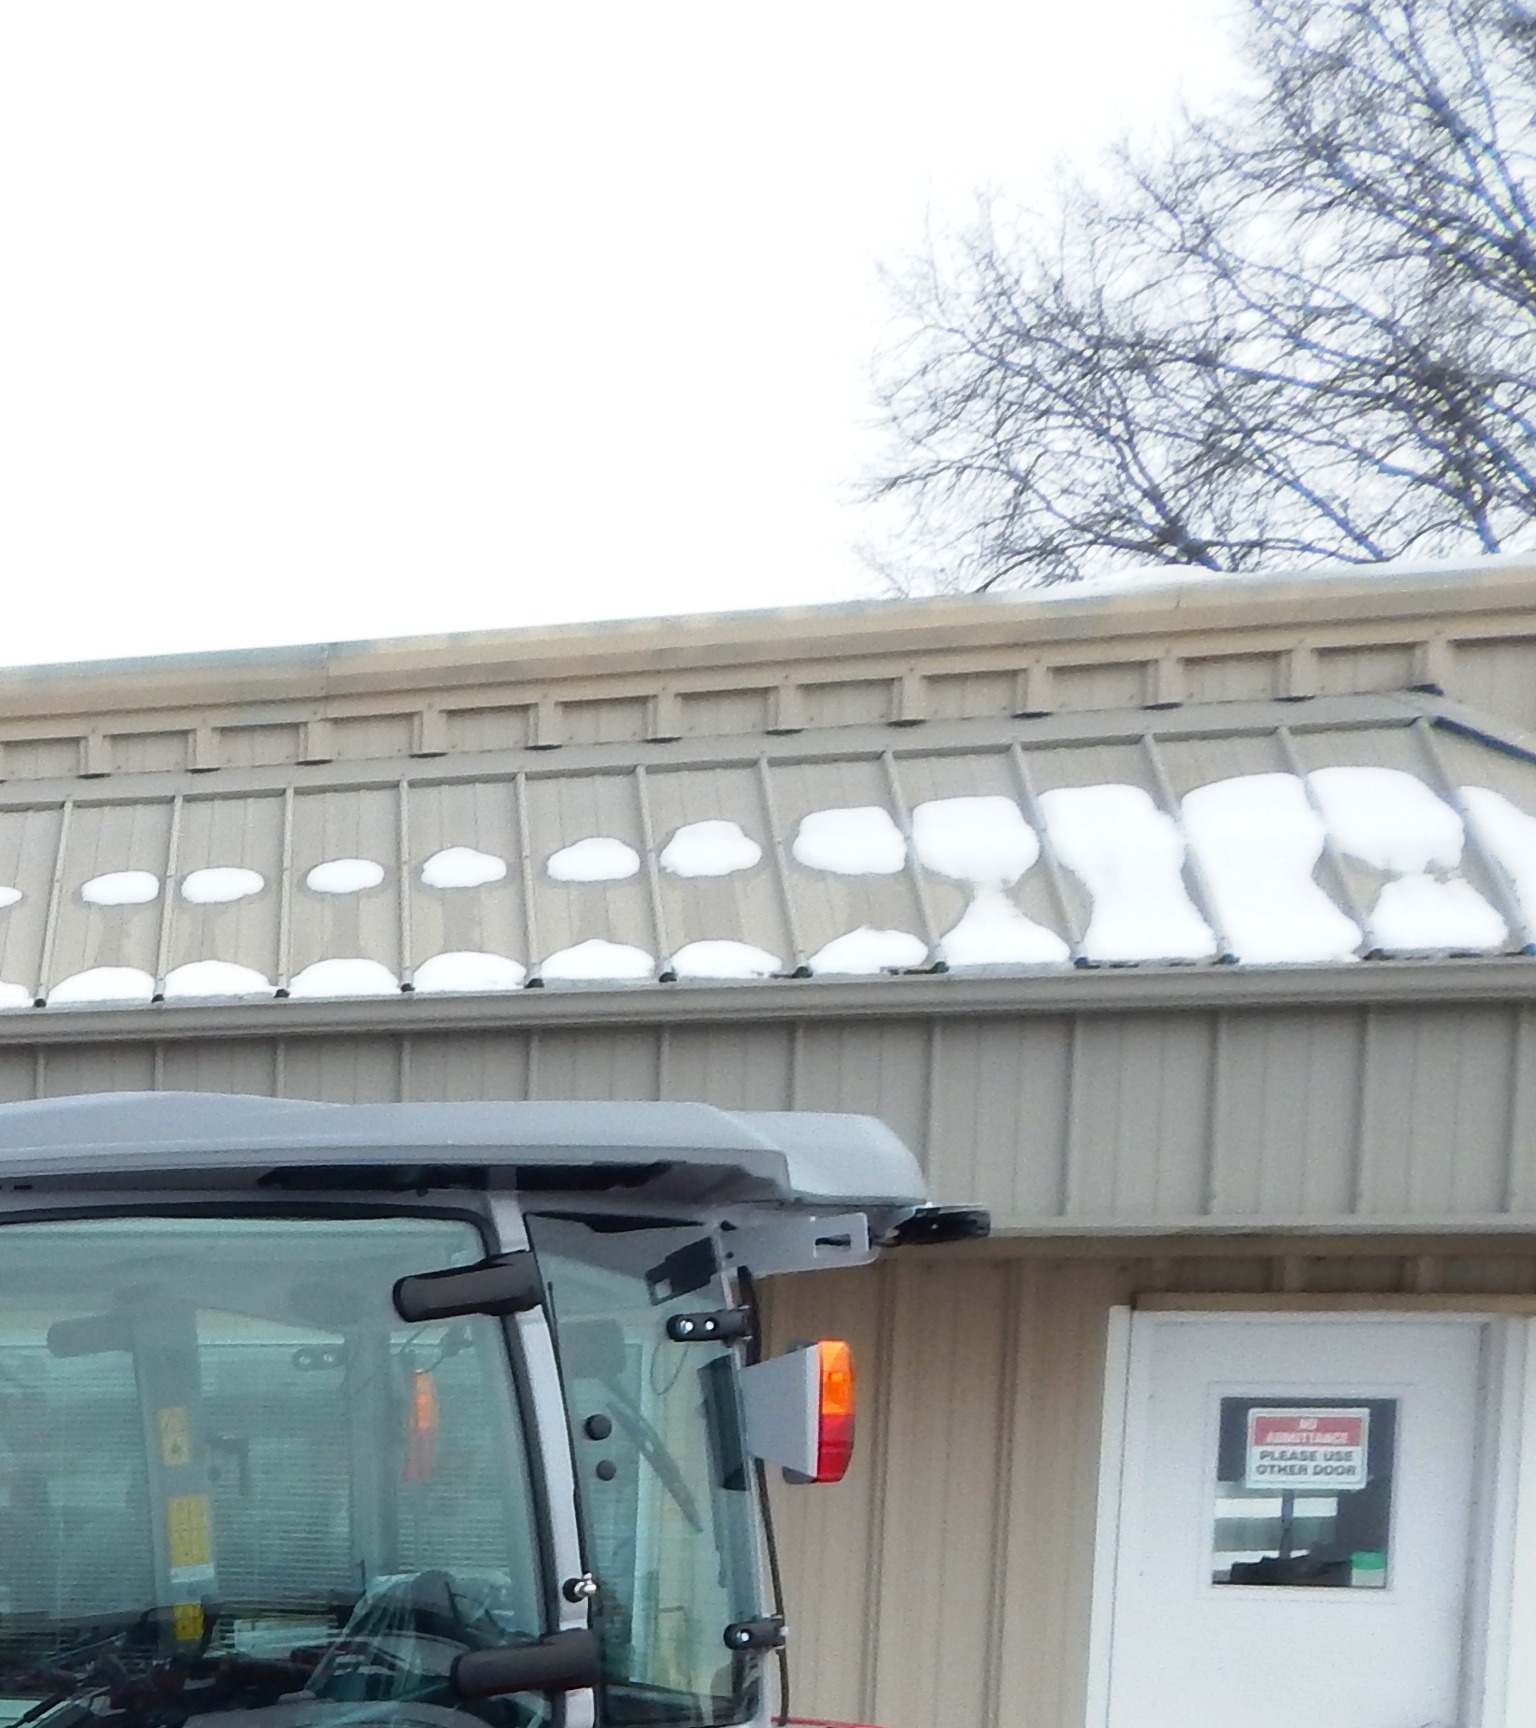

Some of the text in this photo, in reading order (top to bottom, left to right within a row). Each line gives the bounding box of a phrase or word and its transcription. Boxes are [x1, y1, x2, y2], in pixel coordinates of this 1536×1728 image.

[1259, 1450, 1353, 1462] PLEASE USE
[1256, 1464, 1357, 1476] OTHER DOOR
